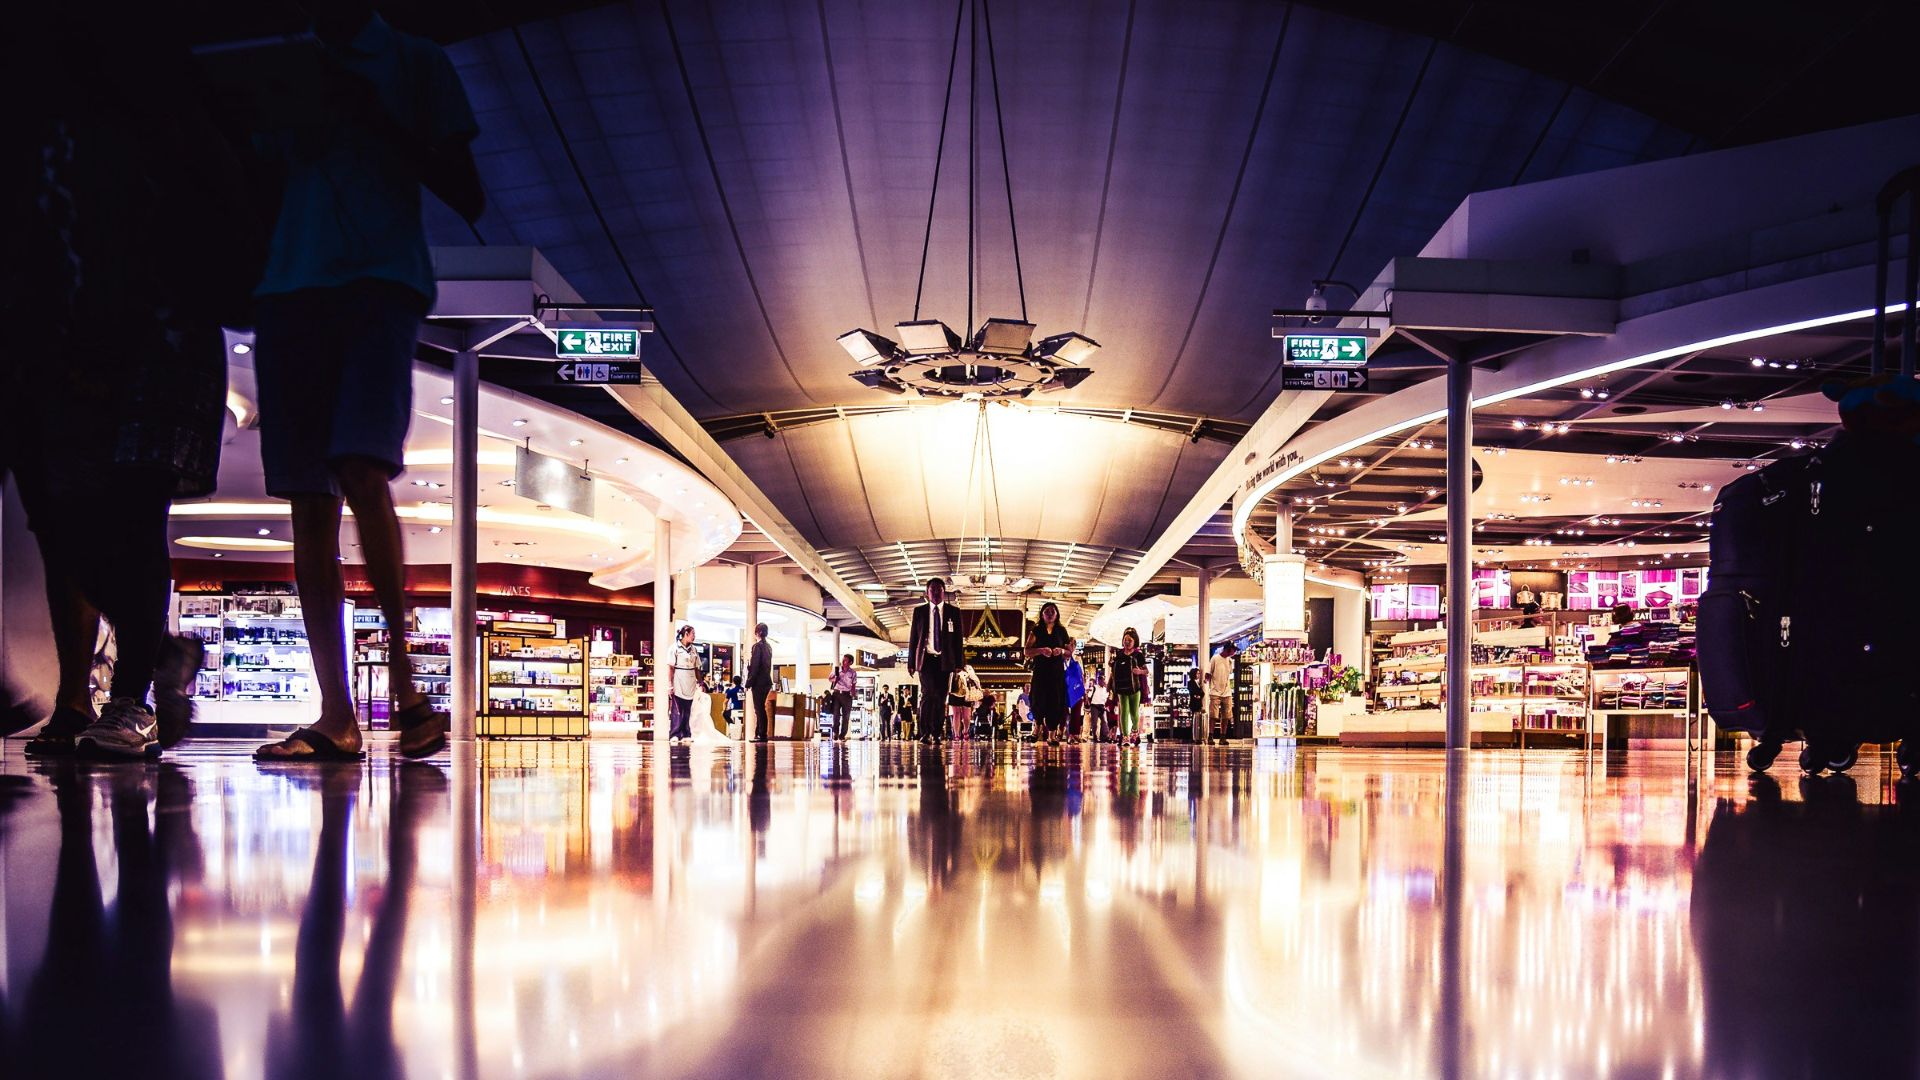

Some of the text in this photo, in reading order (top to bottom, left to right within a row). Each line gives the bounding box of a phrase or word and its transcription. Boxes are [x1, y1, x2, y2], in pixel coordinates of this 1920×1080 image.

[602, 333, 632, 342] FIRE
[602, 342, 632, 352] EXIT
[1291, 339, 1320, 348] FIRE
[1291, 349, 1319, 358] EXIT
[1262, 460, 1275, 478] world
[1275, 453, 1286, 469] with
[499, 585, 531, 597] WINES
